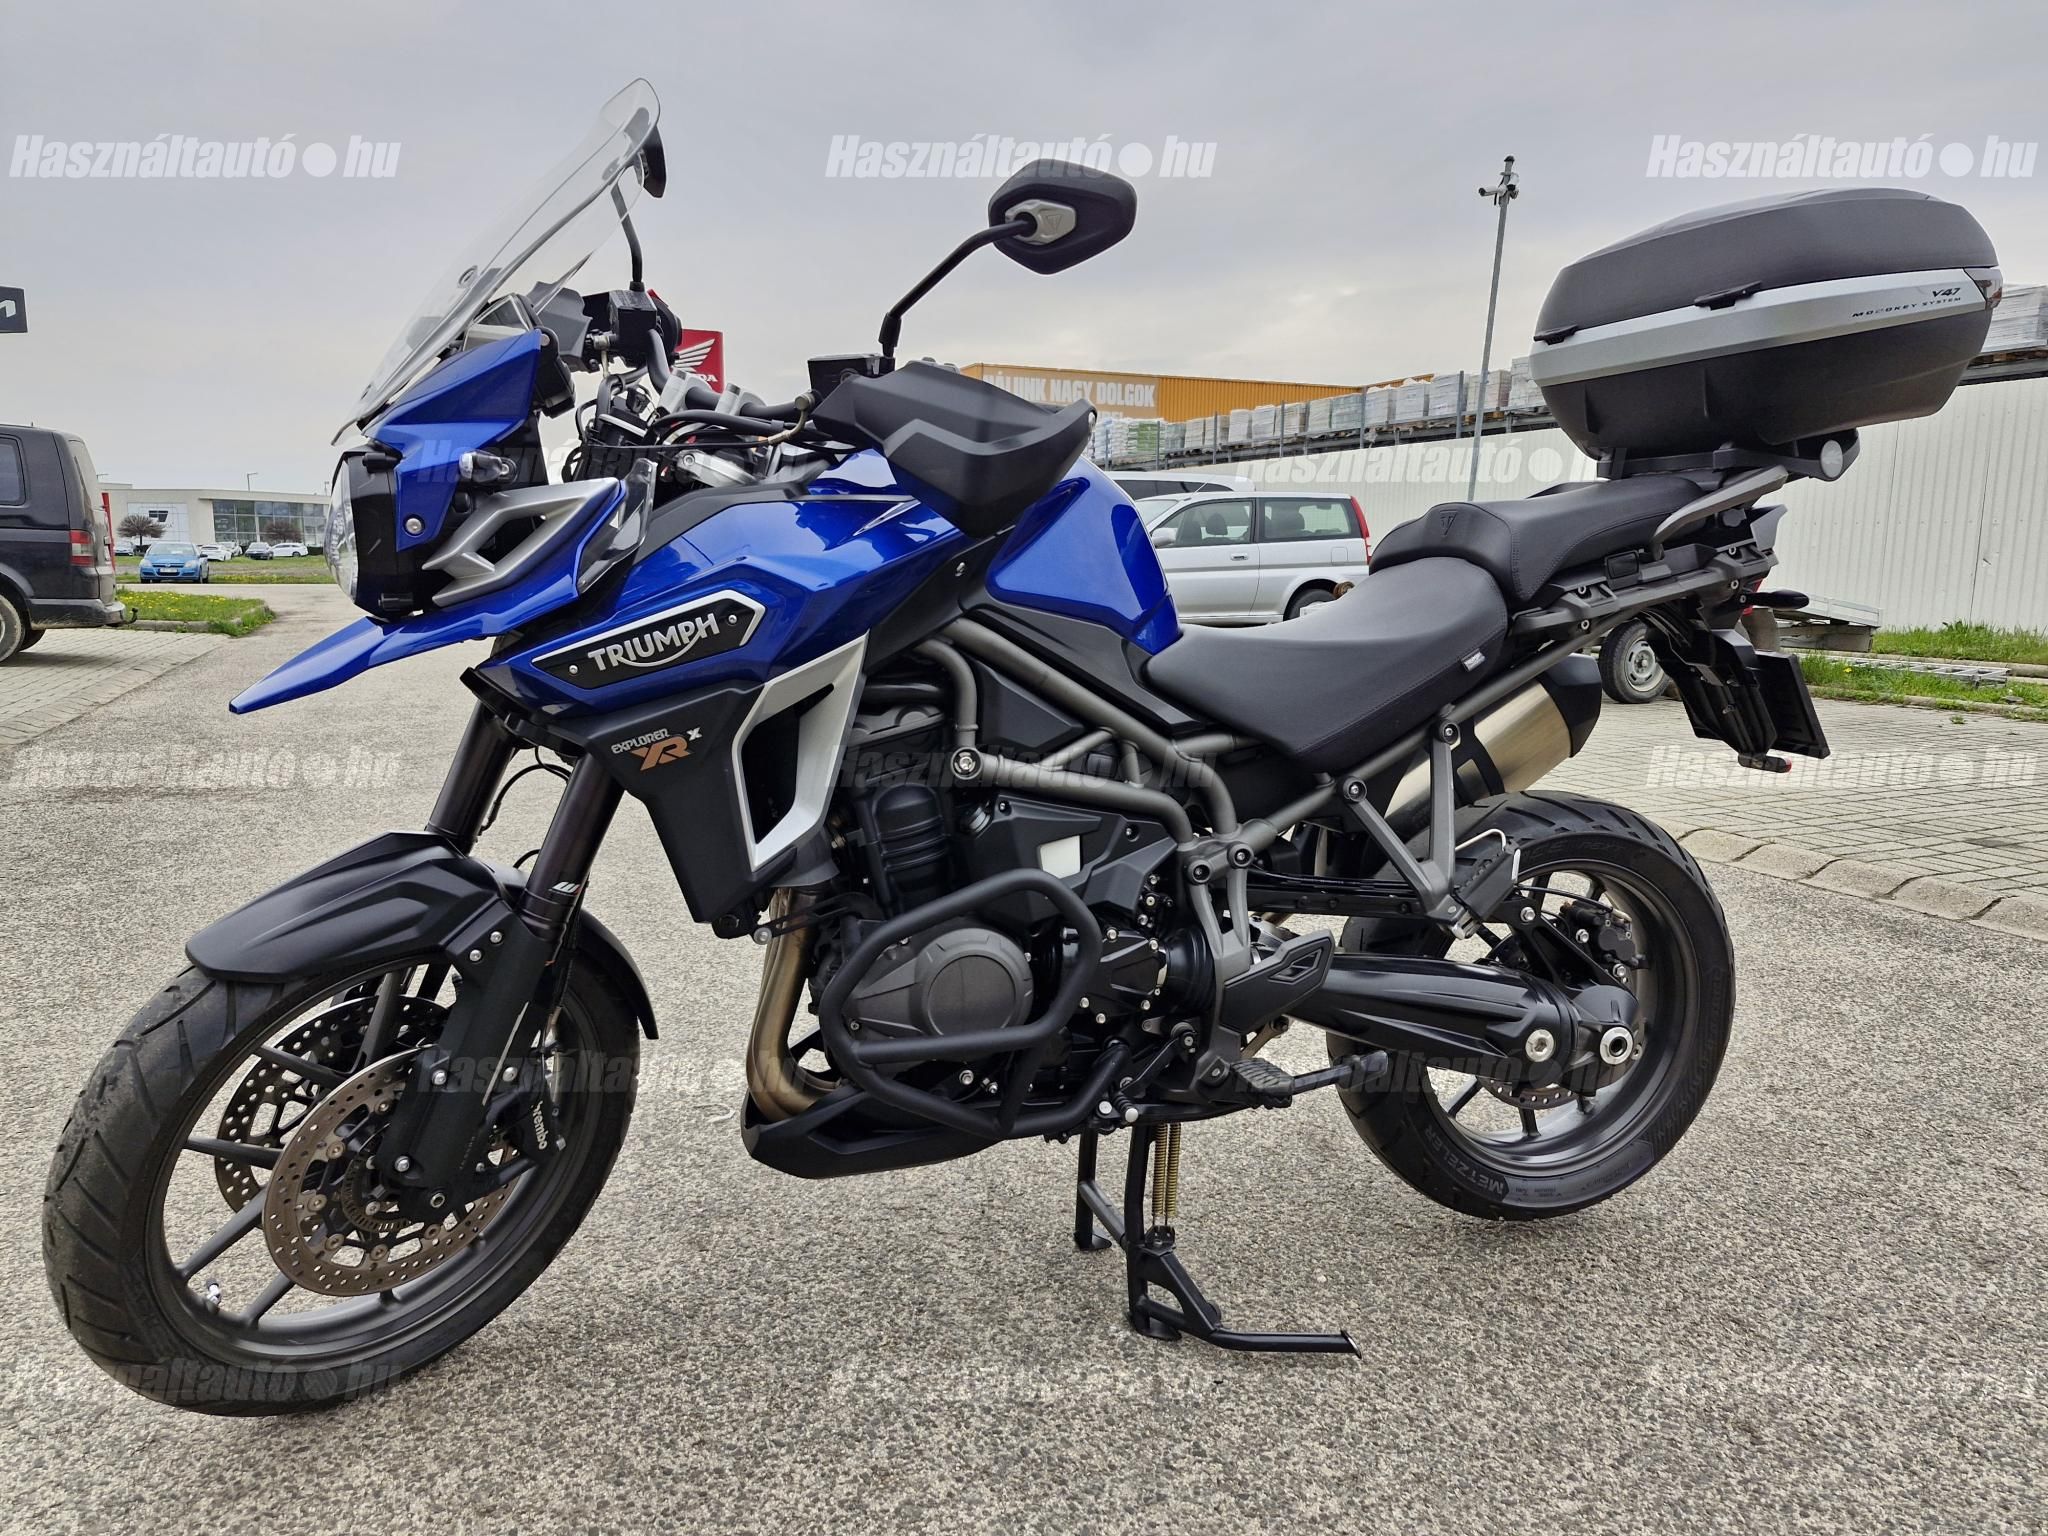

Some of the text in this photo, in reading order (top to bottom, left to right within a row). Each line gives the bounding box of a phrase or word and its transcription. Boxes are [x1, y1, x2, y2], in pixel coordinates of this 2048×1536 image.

[1922, 297, 1962, 307] SYSTEM
[1932, 287, 1961, 298] V47
[1050, 379, 1094, 403] NAGY
[1096, 382, 1157, 408] DOLGOK
[587, 613, 721, 671] TRIUMPH
[611, 728, 670, 755] EXPLORER
[1424, 1125, 1505, 1195] METZELER
